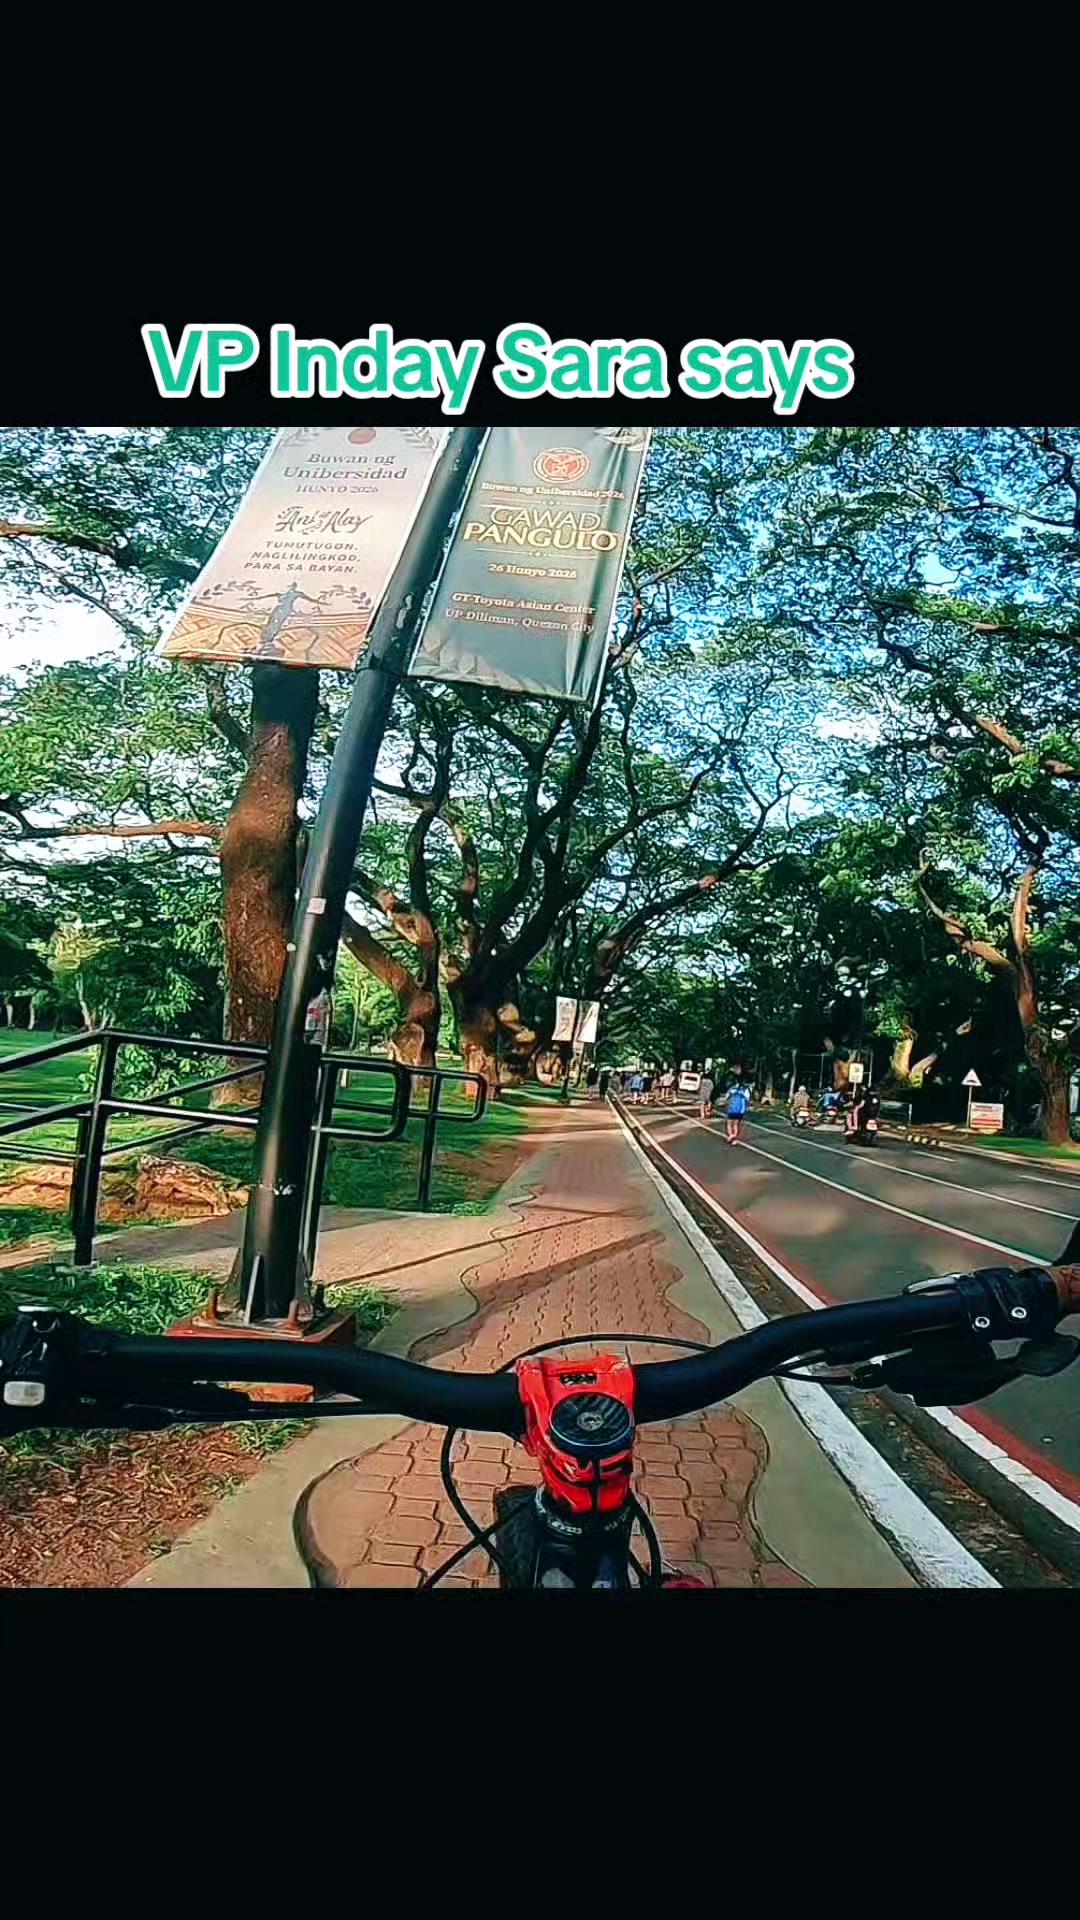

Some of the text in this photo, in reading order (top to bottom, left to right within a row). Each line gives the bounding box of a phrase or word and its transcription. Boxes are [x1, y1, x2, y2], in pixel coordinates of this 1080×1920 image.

[307, 453, 396, 466] Buwan ng
[283, 466, 408, 480] Unibersidad
[296, 485, 347, 493] HUNYO
[481, 482, 625, 499] Buwan ng Unibersidad 2026
[275, 506, 320, 533] Ani
[320, 508, 374, 534] Alay
[489, 506, 601, 531] GAWAD
[463, 522, 619, 552] PANGULO
[266, 541, 359, 551] TUMUTUGON.
[251, 552, 361, 563] NAGLILINGKOD.
[244, 562, 358, 574] PARA SA BAYAN.
[489, 563, 577, 579] 26 Hunyo 2026
[452, 592, 596, 614] GT-Toyota Asian Center
[446, 607, 595, 634] UP Diliman, Quezon City
